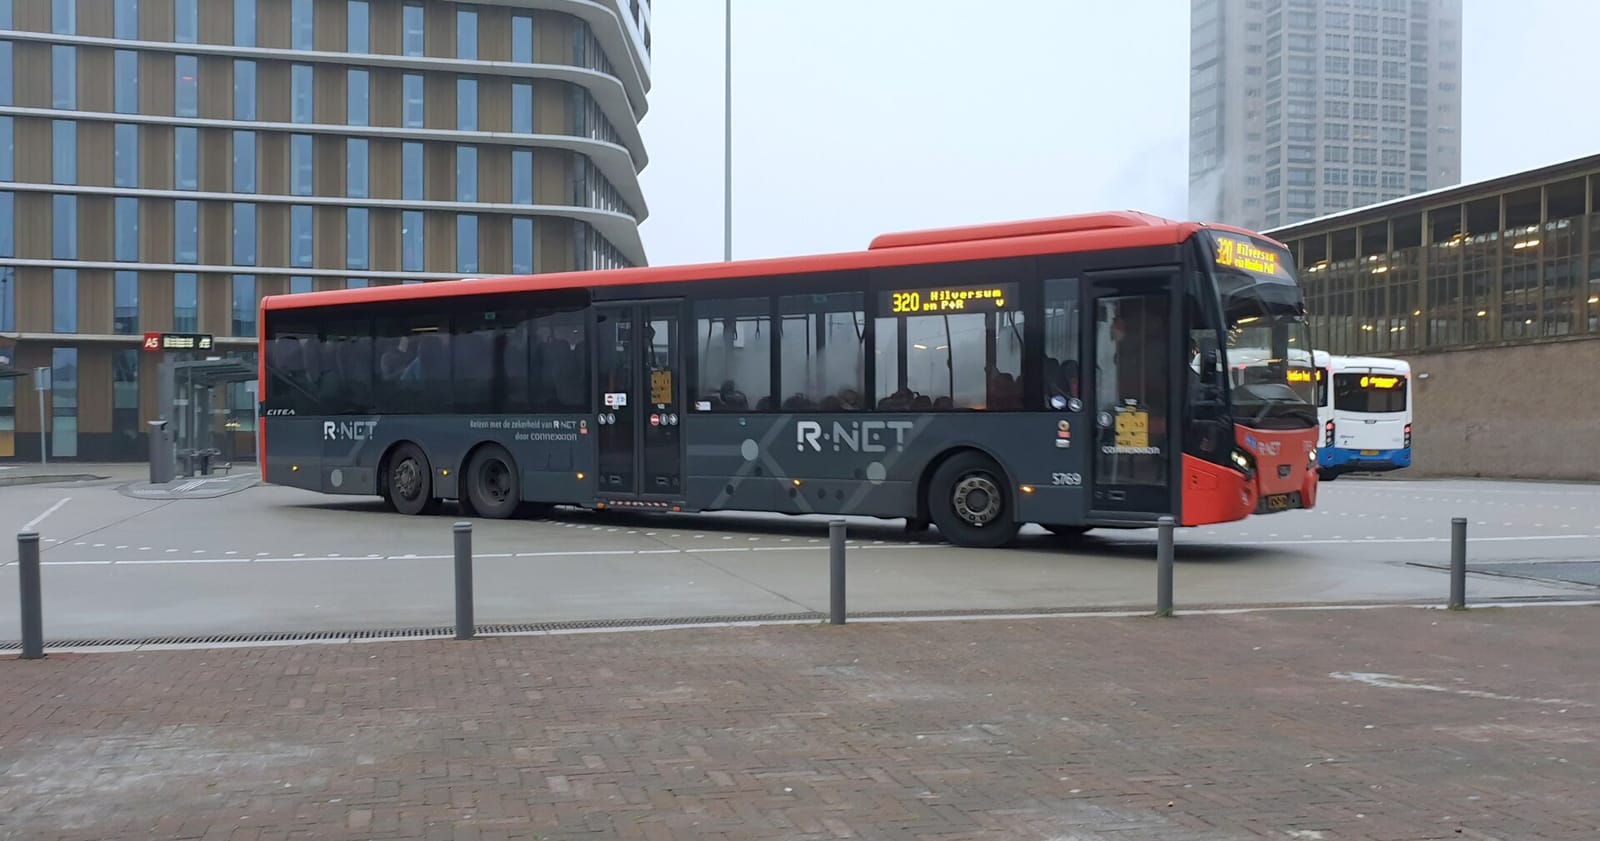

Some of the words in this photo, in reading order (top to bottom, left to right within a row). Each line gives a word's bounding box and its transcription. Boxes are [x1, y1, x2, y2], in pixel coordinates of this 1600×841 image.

[892, 292, 920, 312] 320
[930, 289, 1002, 301] Hilversum
[266, 408, 296, 416] CITEA
[1052, 472, 1082, 485] 5769
